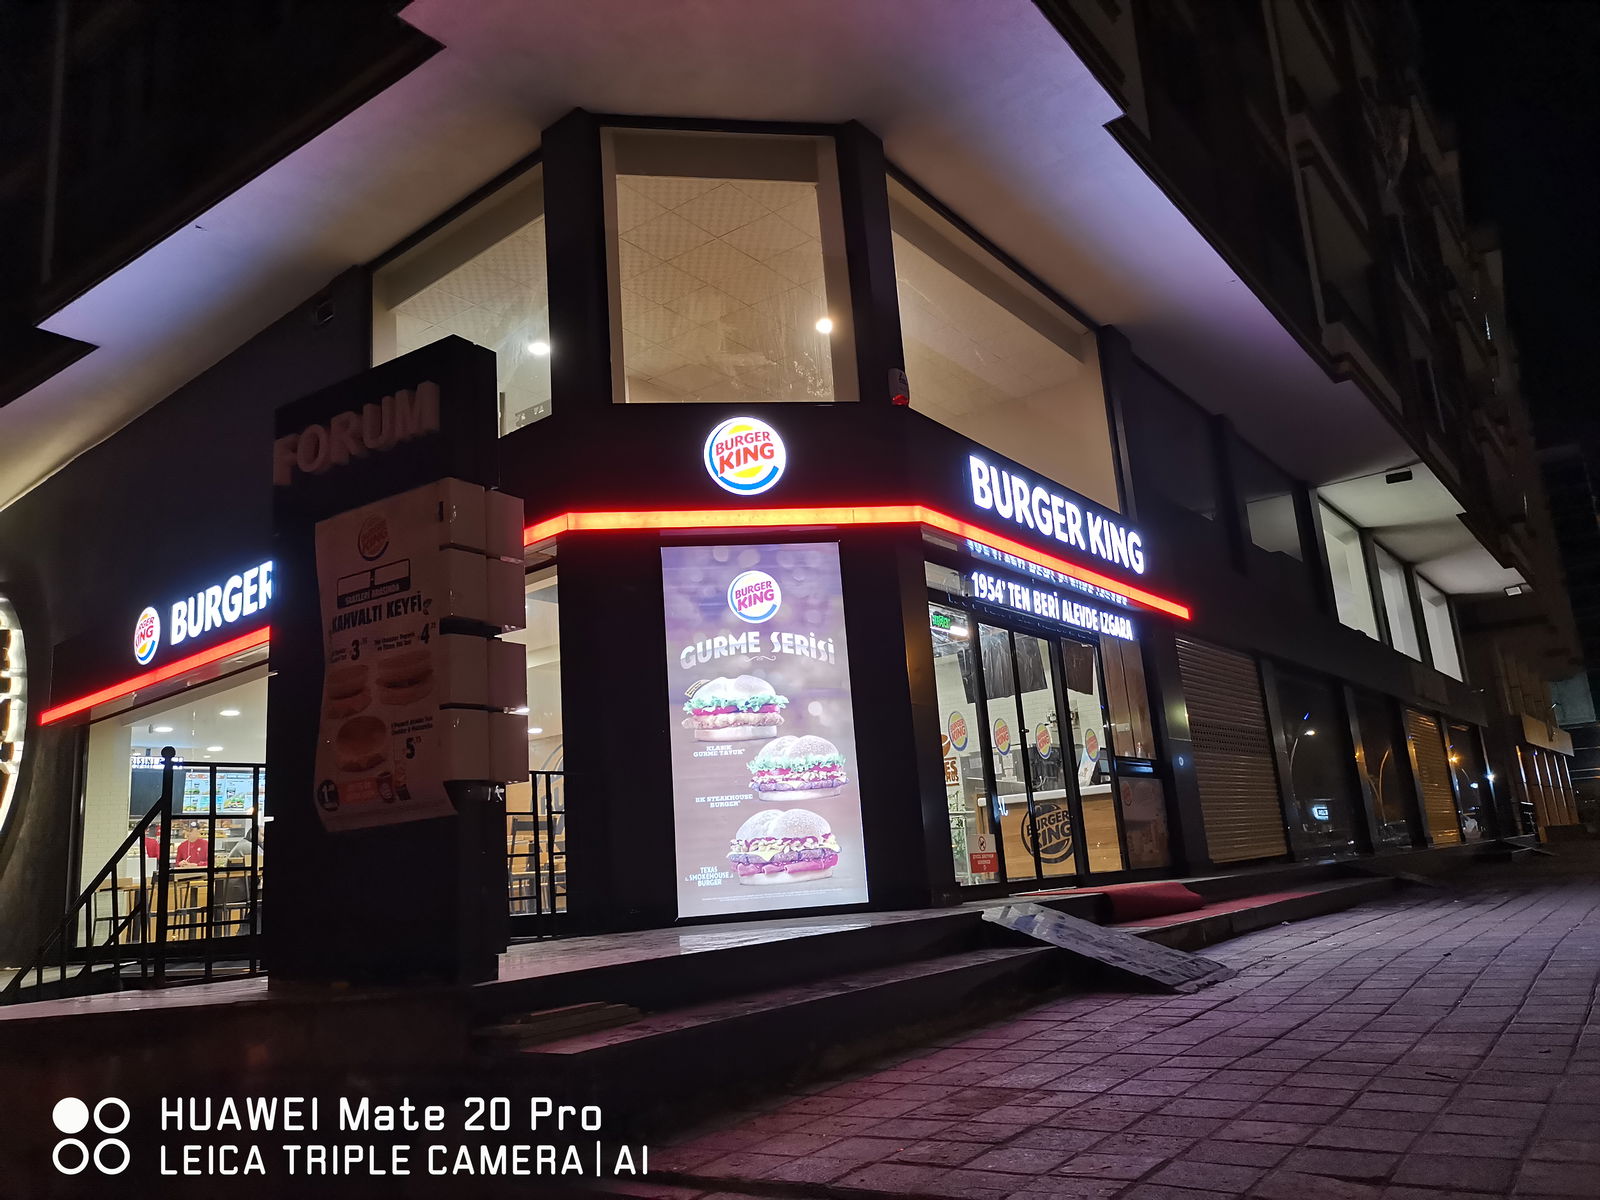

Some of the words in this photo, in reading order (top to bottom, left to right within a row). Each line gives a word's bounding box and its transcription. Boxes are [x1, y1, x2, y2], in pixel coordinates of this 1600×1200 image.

[273, 380, 440, 486] FORUM
[715, 431, 771, 457] BURGER
[718, 443, 775, 475] KING
[969, 455, 1086, 551] BURGER
[1086, 511, 1144, 575] KING
[735, 580, 772, 600] BURGER
[737, 588, 775, 613] KING
[333, 604, 382, 633] KAHVALTI
[1007, 580, 1031, 612] TEN
[1062, 600, 1099, 632] ALEVDE
[1100, 611, 1134, 641] IZGARA
[680, 631, 760, 670] GURME
[769, 631, 836, 666] SERİSİ
[689, 871, 729, 881] SMOKEHOUSE
[697, 879, 722, 887] BURGER
[700, 866, 718, 874] TEXAS
